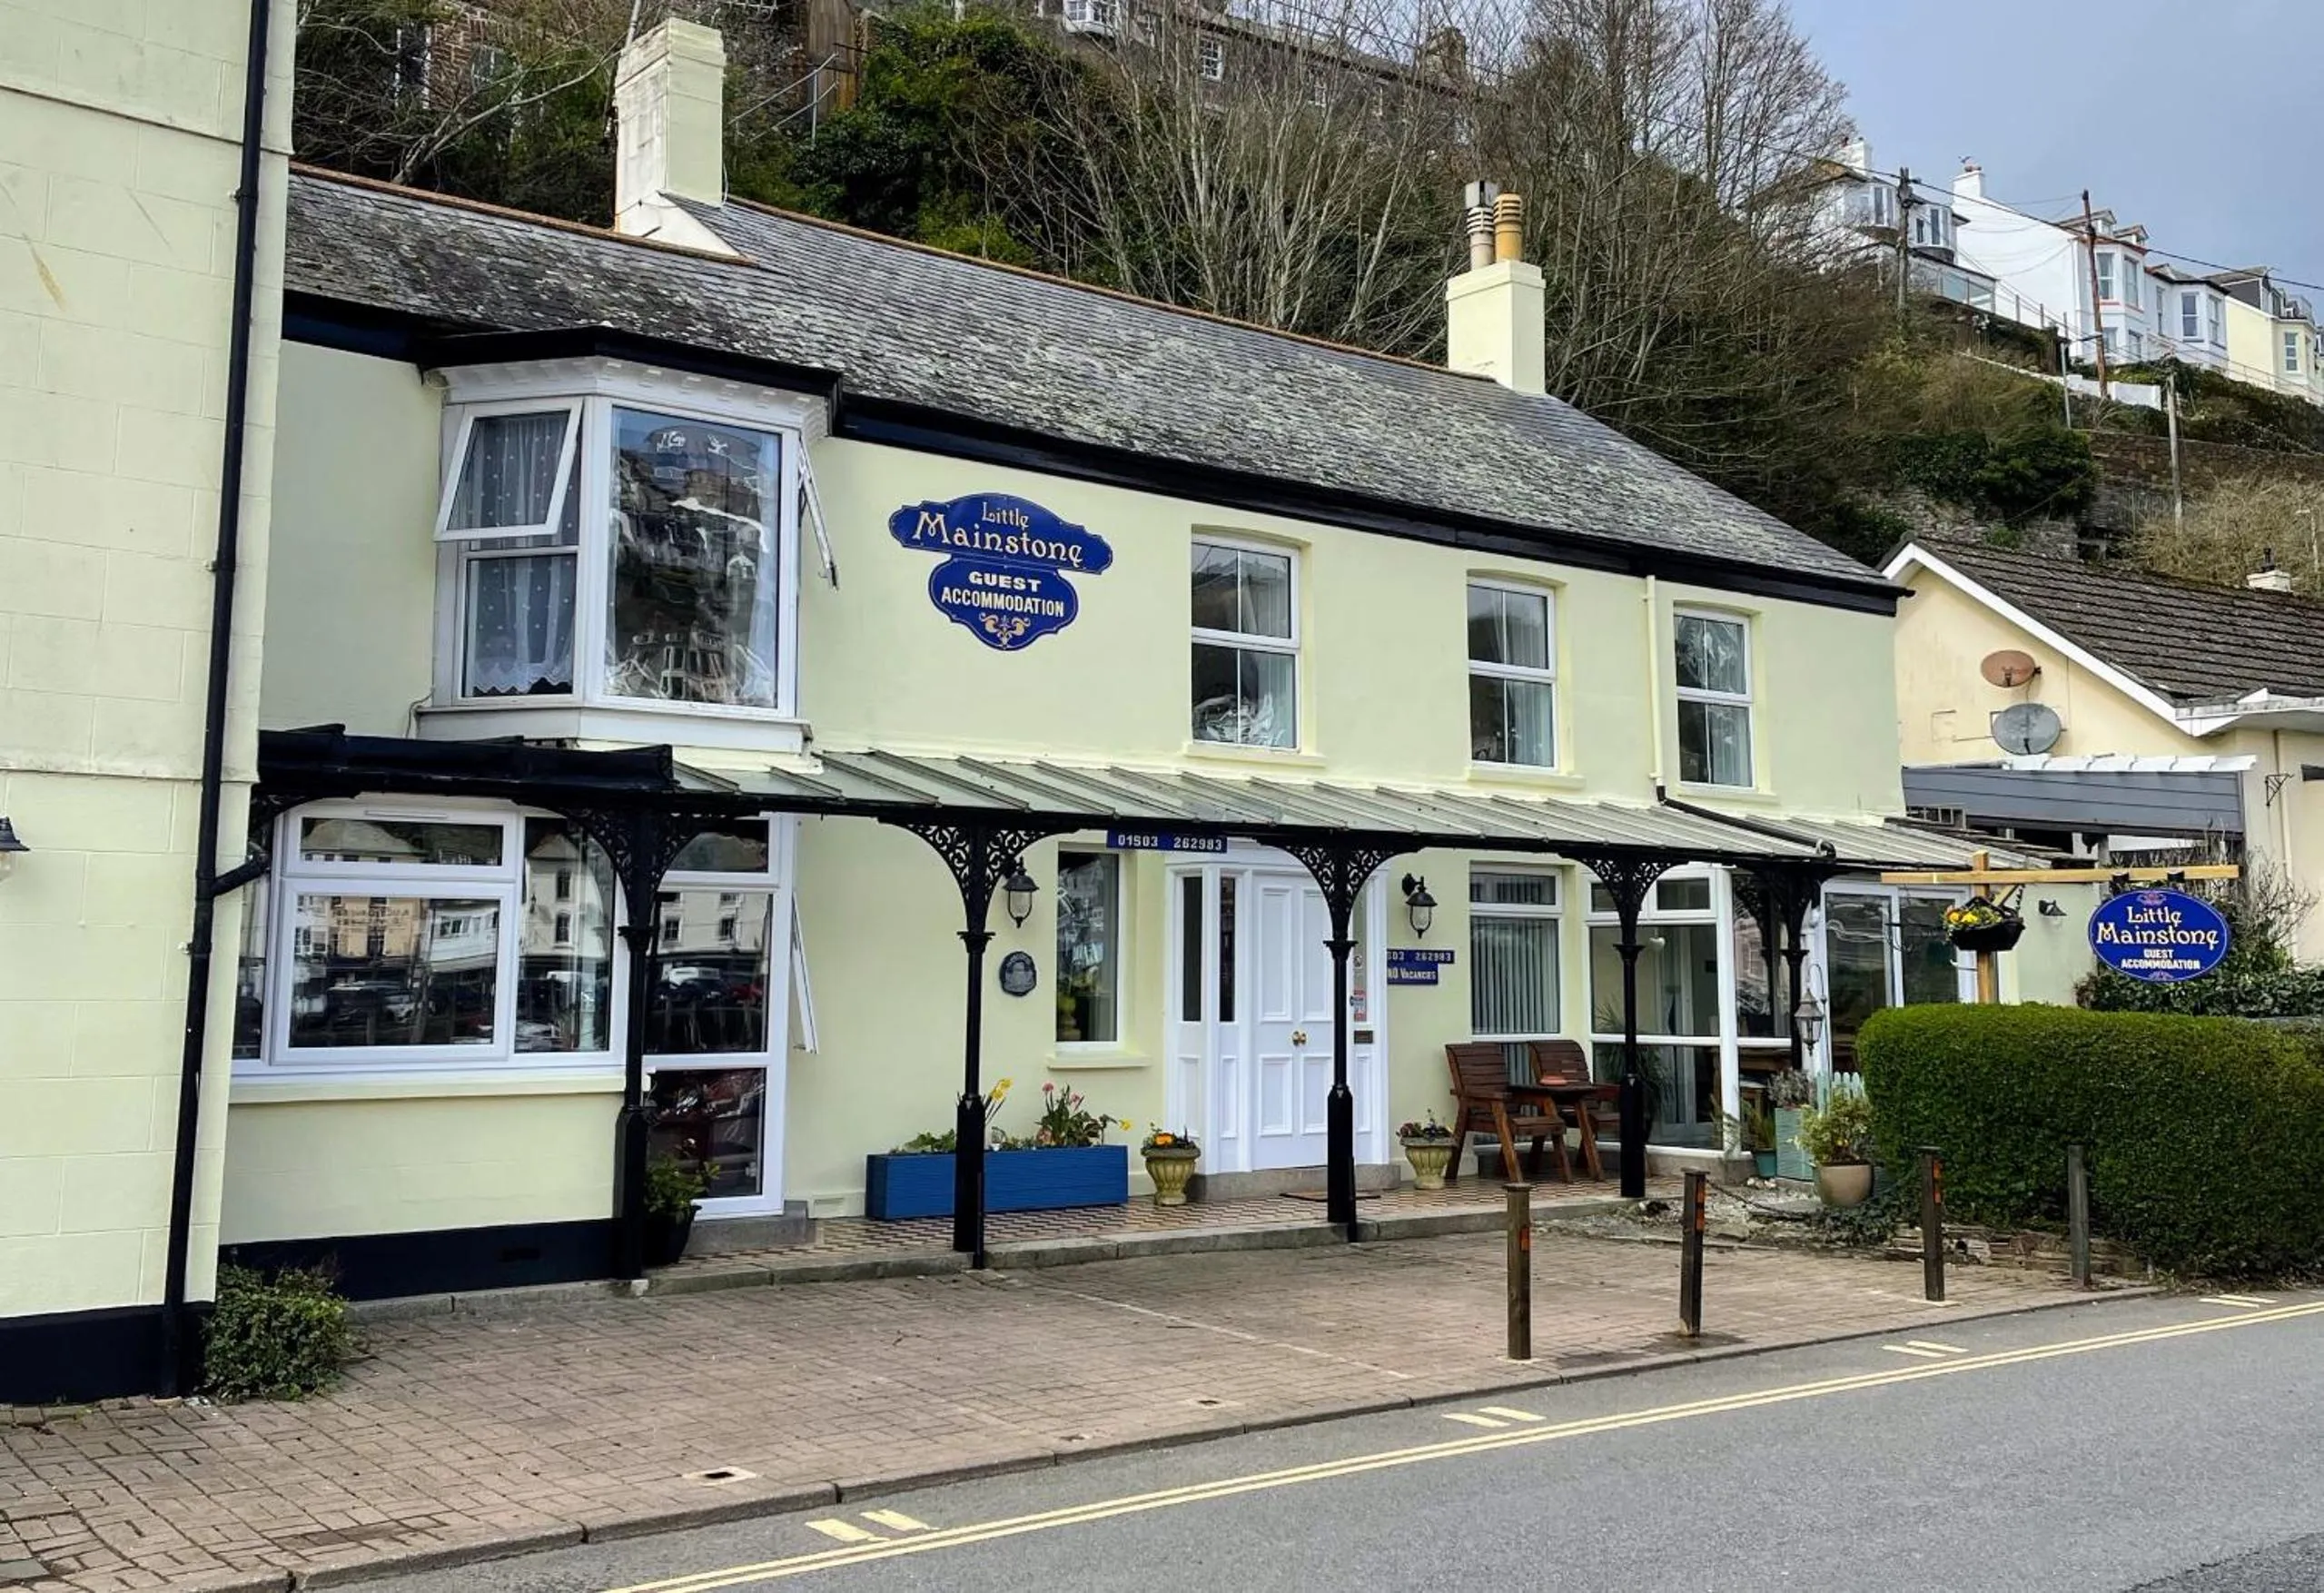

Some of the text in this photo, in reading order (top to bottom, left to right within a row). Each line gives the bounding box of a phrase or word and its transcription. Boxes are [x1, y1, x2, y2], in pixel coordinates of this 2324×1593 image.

[982, 501, 1029, 529] Little
[912, 510, 1083, 567] Mainstone
[968, 571, 1042, 592] GUEST
[941, 587, 1064, 618] ACCOMMODATION
[1173, 836, 1222, 850] 262983
[2126, 906, 2182, 926] Little
[2096, 922, 2220, 951] Mainstone
[2121, 958, 2200, 970] ACCOMMODATION
[2143, 948, 2174, 959] GUEST
